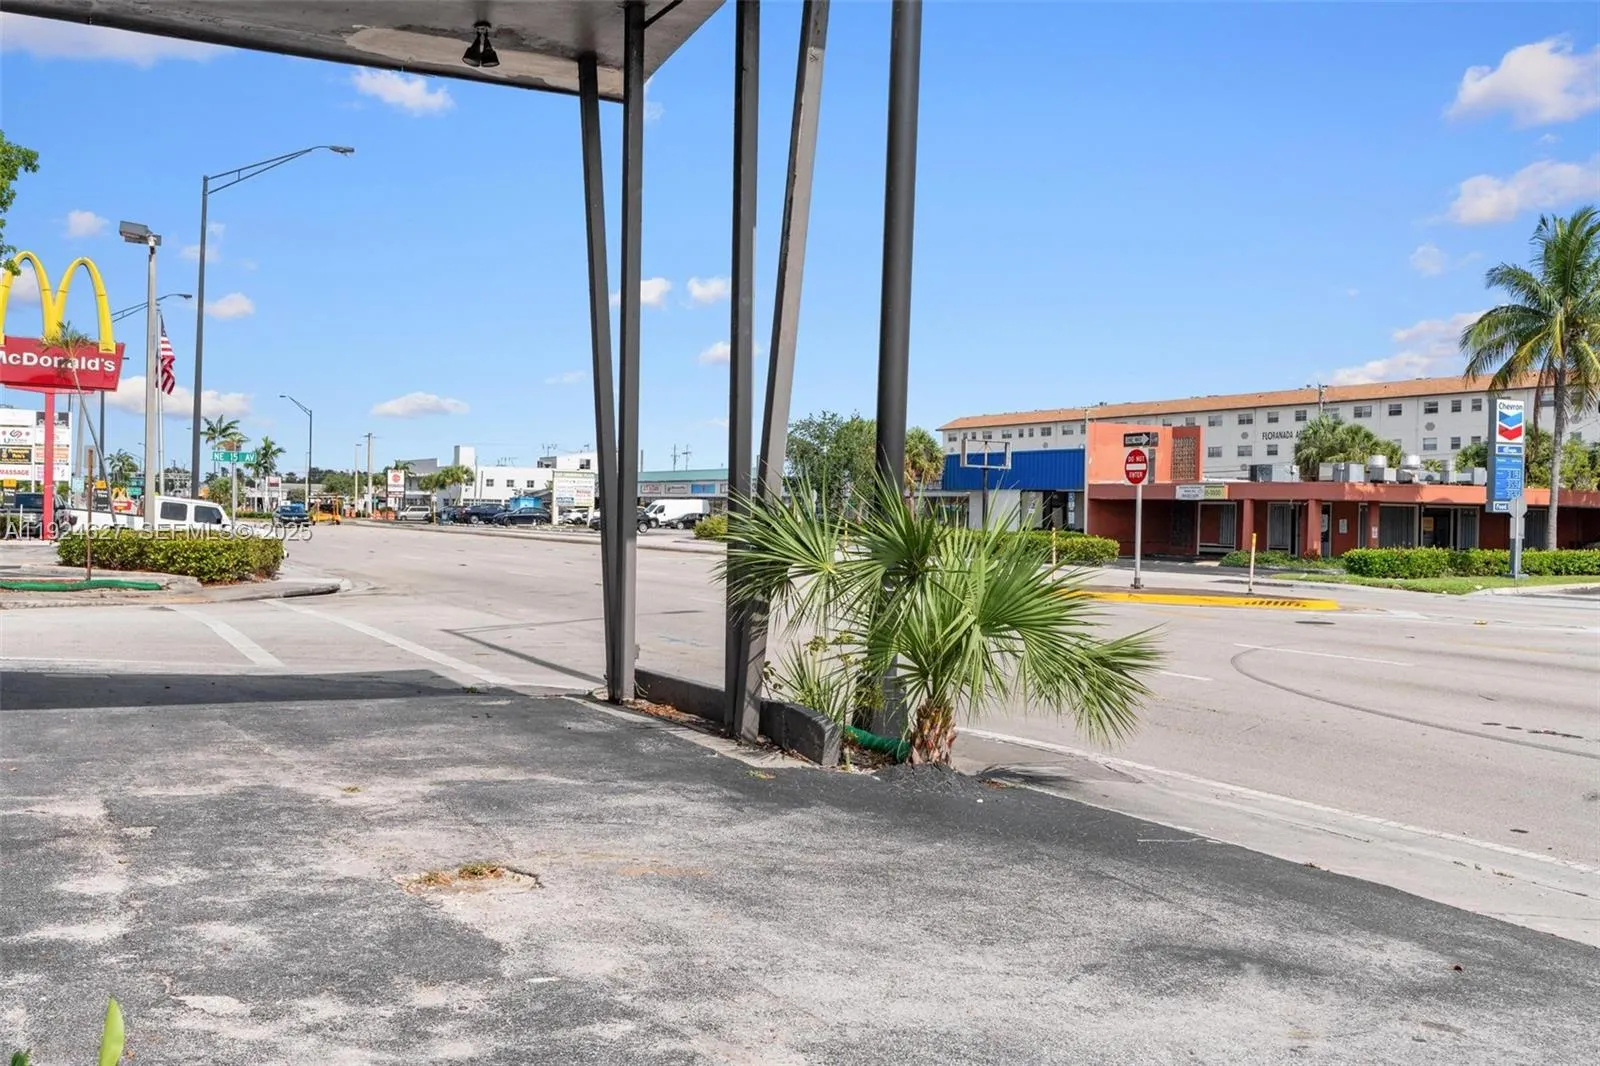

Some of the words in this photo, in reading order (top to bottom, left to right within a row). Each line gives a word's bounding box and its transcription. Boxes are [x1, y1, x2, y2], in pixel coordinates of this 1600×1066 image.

[1498, 402, 1523, 410] Chevron
[1262, 431, 1293, 441] FLORANADA
[213, 452, 224, 461] NE
[230, 452, 238, 462] 15
[1127, 455, 1135, 463] DO
[1135, 455, 1145, 463] NOT
[1128, 471, 1143, 479] ENTER
